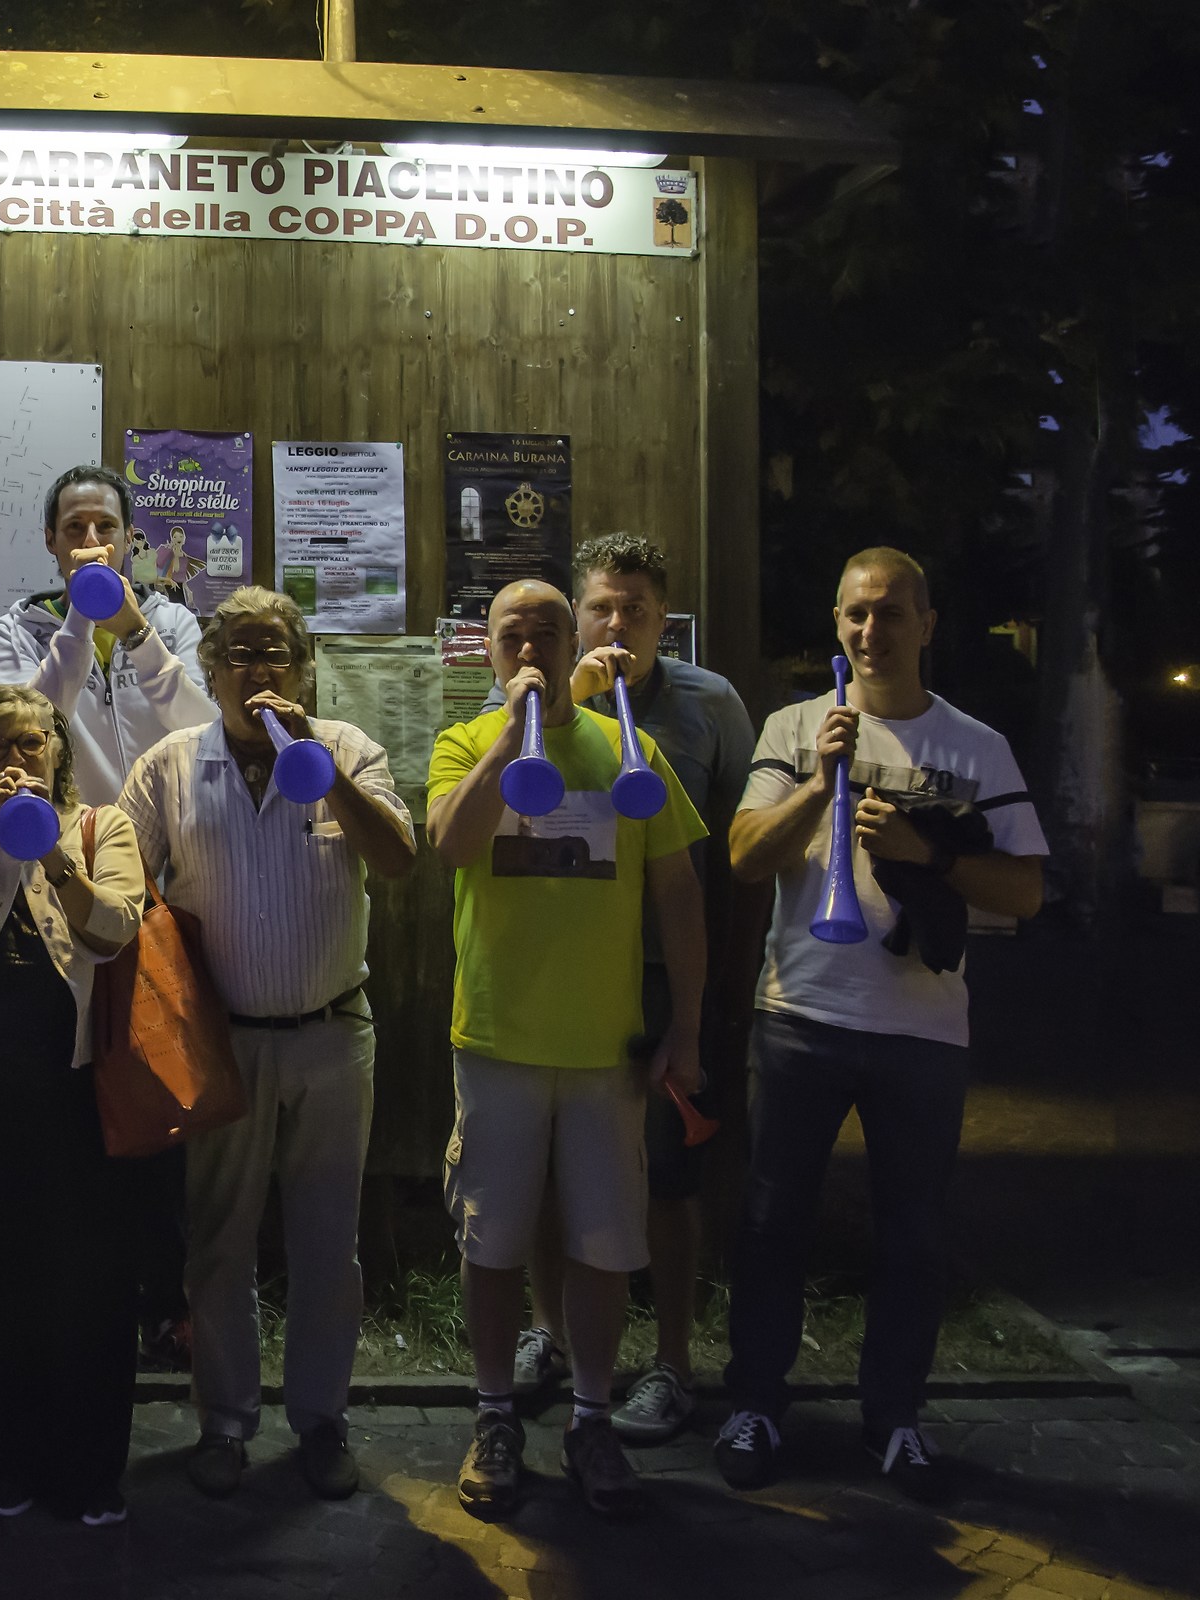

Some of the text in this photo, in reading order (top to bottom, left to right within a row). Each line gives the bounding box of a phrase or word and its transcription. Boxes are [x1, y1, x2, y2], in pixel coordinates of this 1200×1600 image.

[303, 157, 614, 208] PIACENTINO
[133, 202, 251, 232] della
[268, 205, 437, 240] COPPA
[455, 212, 595, 246] D.O.P.
[287, 446, 339, 457] LEGGIO
[147, 473, 226, 497] Shopping
[135, 492, 240, 510] sotto le stelle
